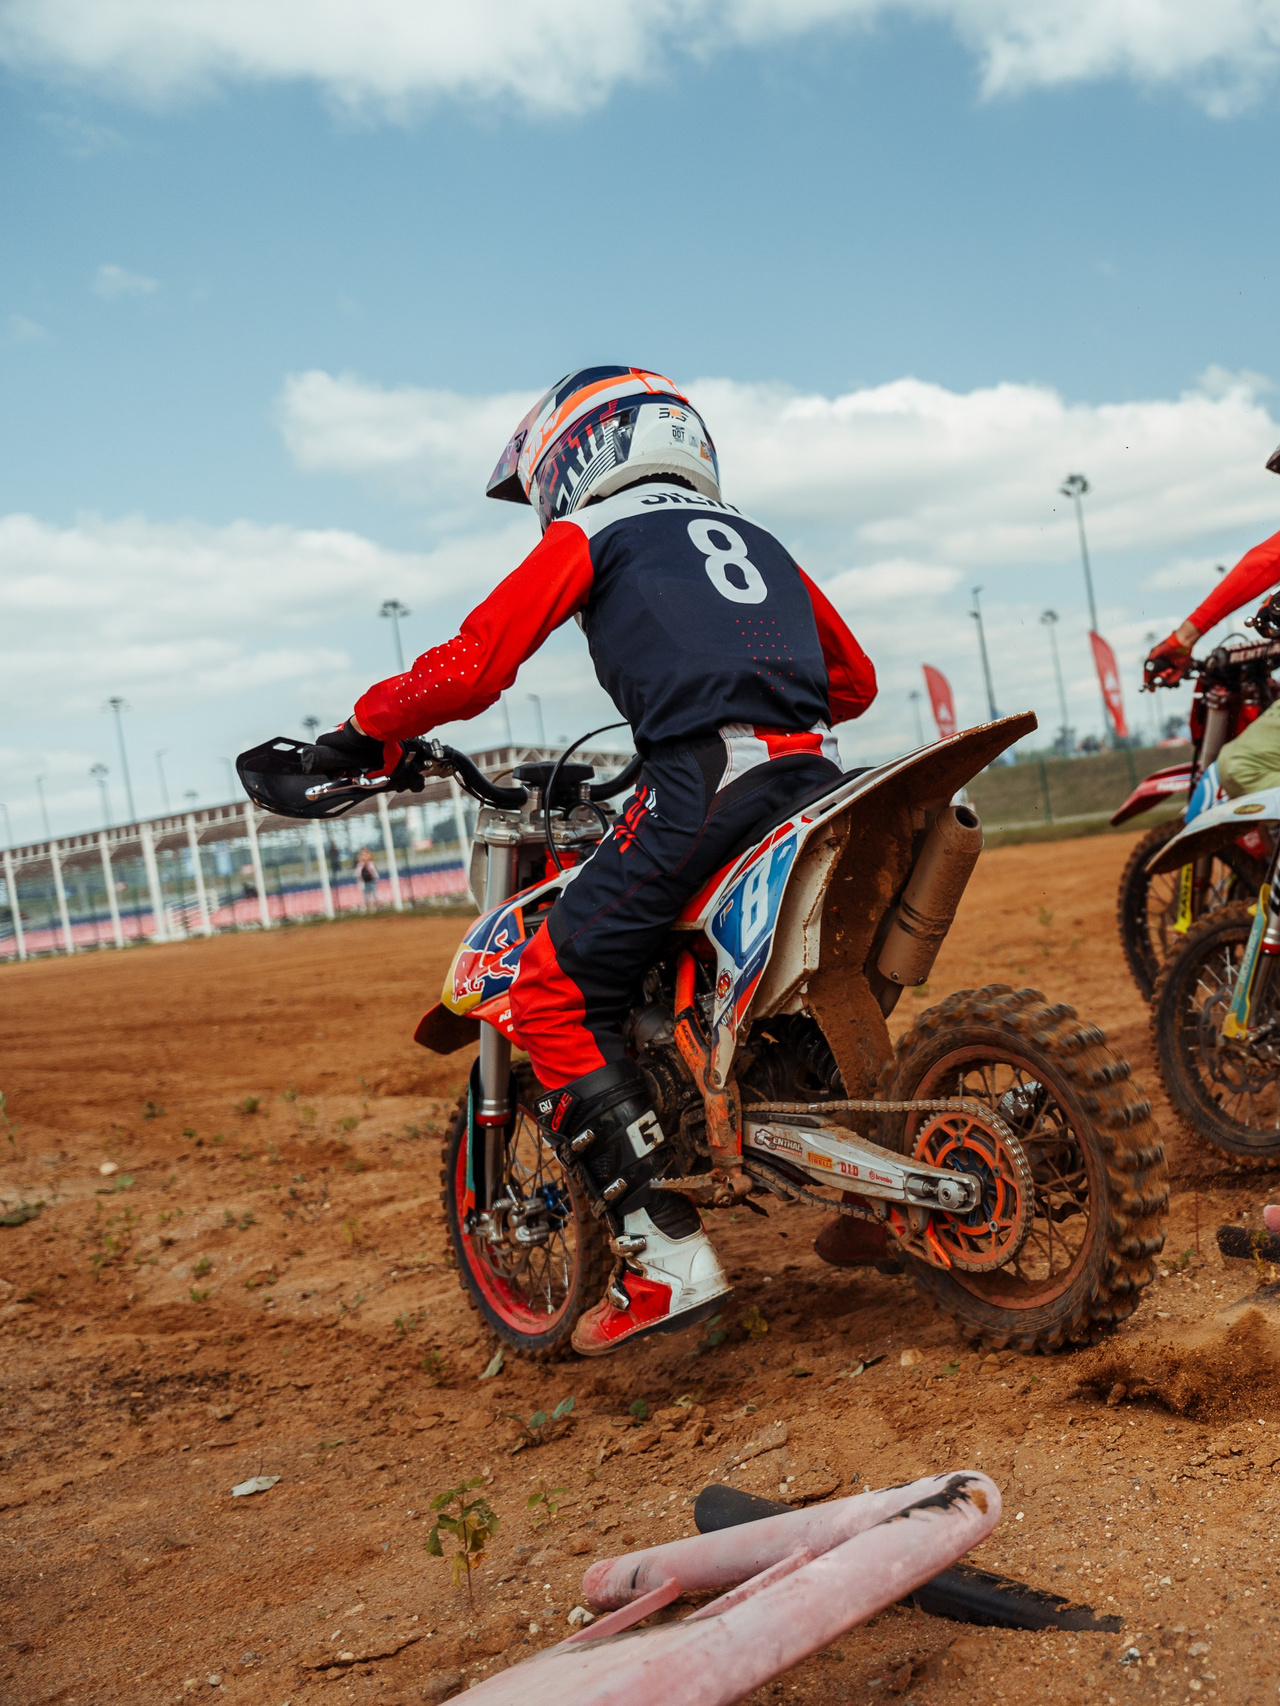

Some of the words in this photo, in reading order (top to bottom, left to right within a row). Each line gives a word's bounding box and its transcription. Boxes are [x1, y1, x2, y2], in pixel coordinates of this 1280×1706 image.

[672, 429, 685, 440] DOT
[687, 518, 768, 604] 8
[740, 863, 770, 954] 8
[626, 1109, 665, 1158] G
[808, 1152, 832, 1169] PIRELLI
